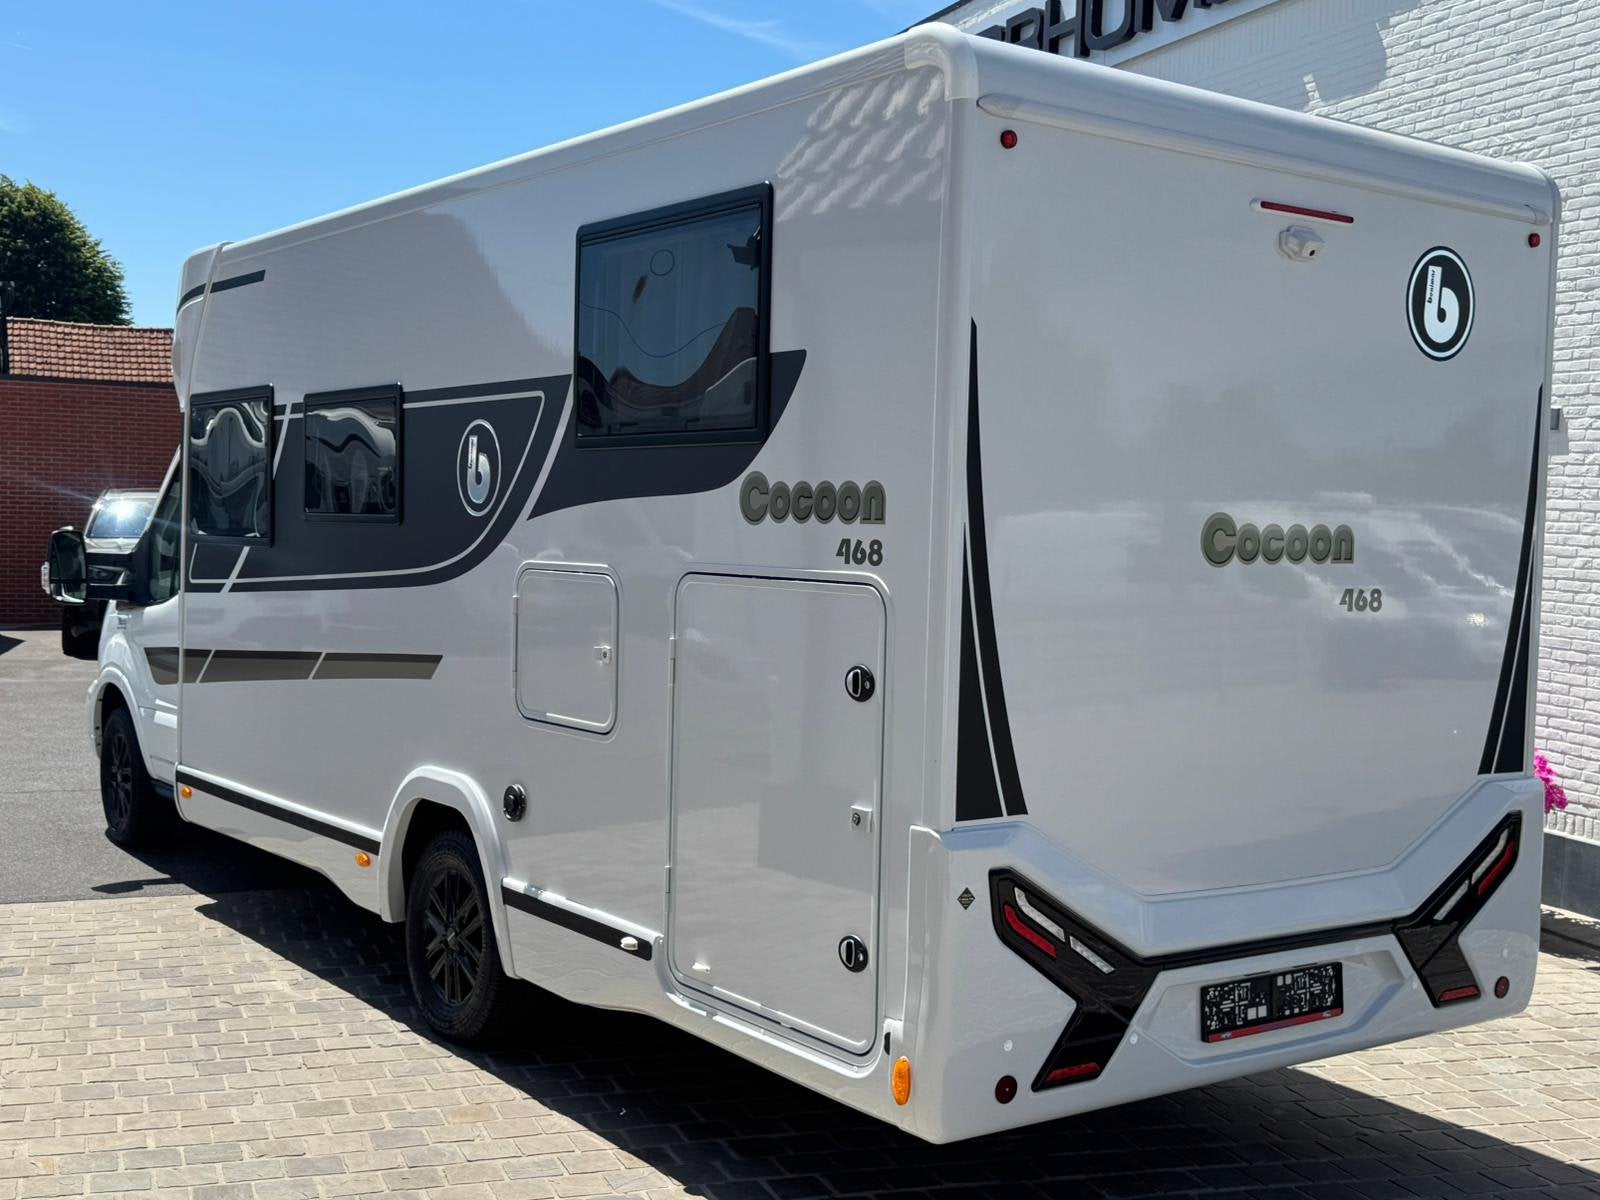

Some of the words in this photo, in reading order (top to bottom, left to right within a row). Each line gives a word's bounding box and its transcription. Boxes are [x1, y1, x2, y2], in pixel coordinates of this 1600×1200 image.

[739, 471, 886, 525] Cocoon
[835, 538, 883, 567] 468
[1201, 512, 1355, 568] Cocoon
[1339, 588, 1382, 612] 468
